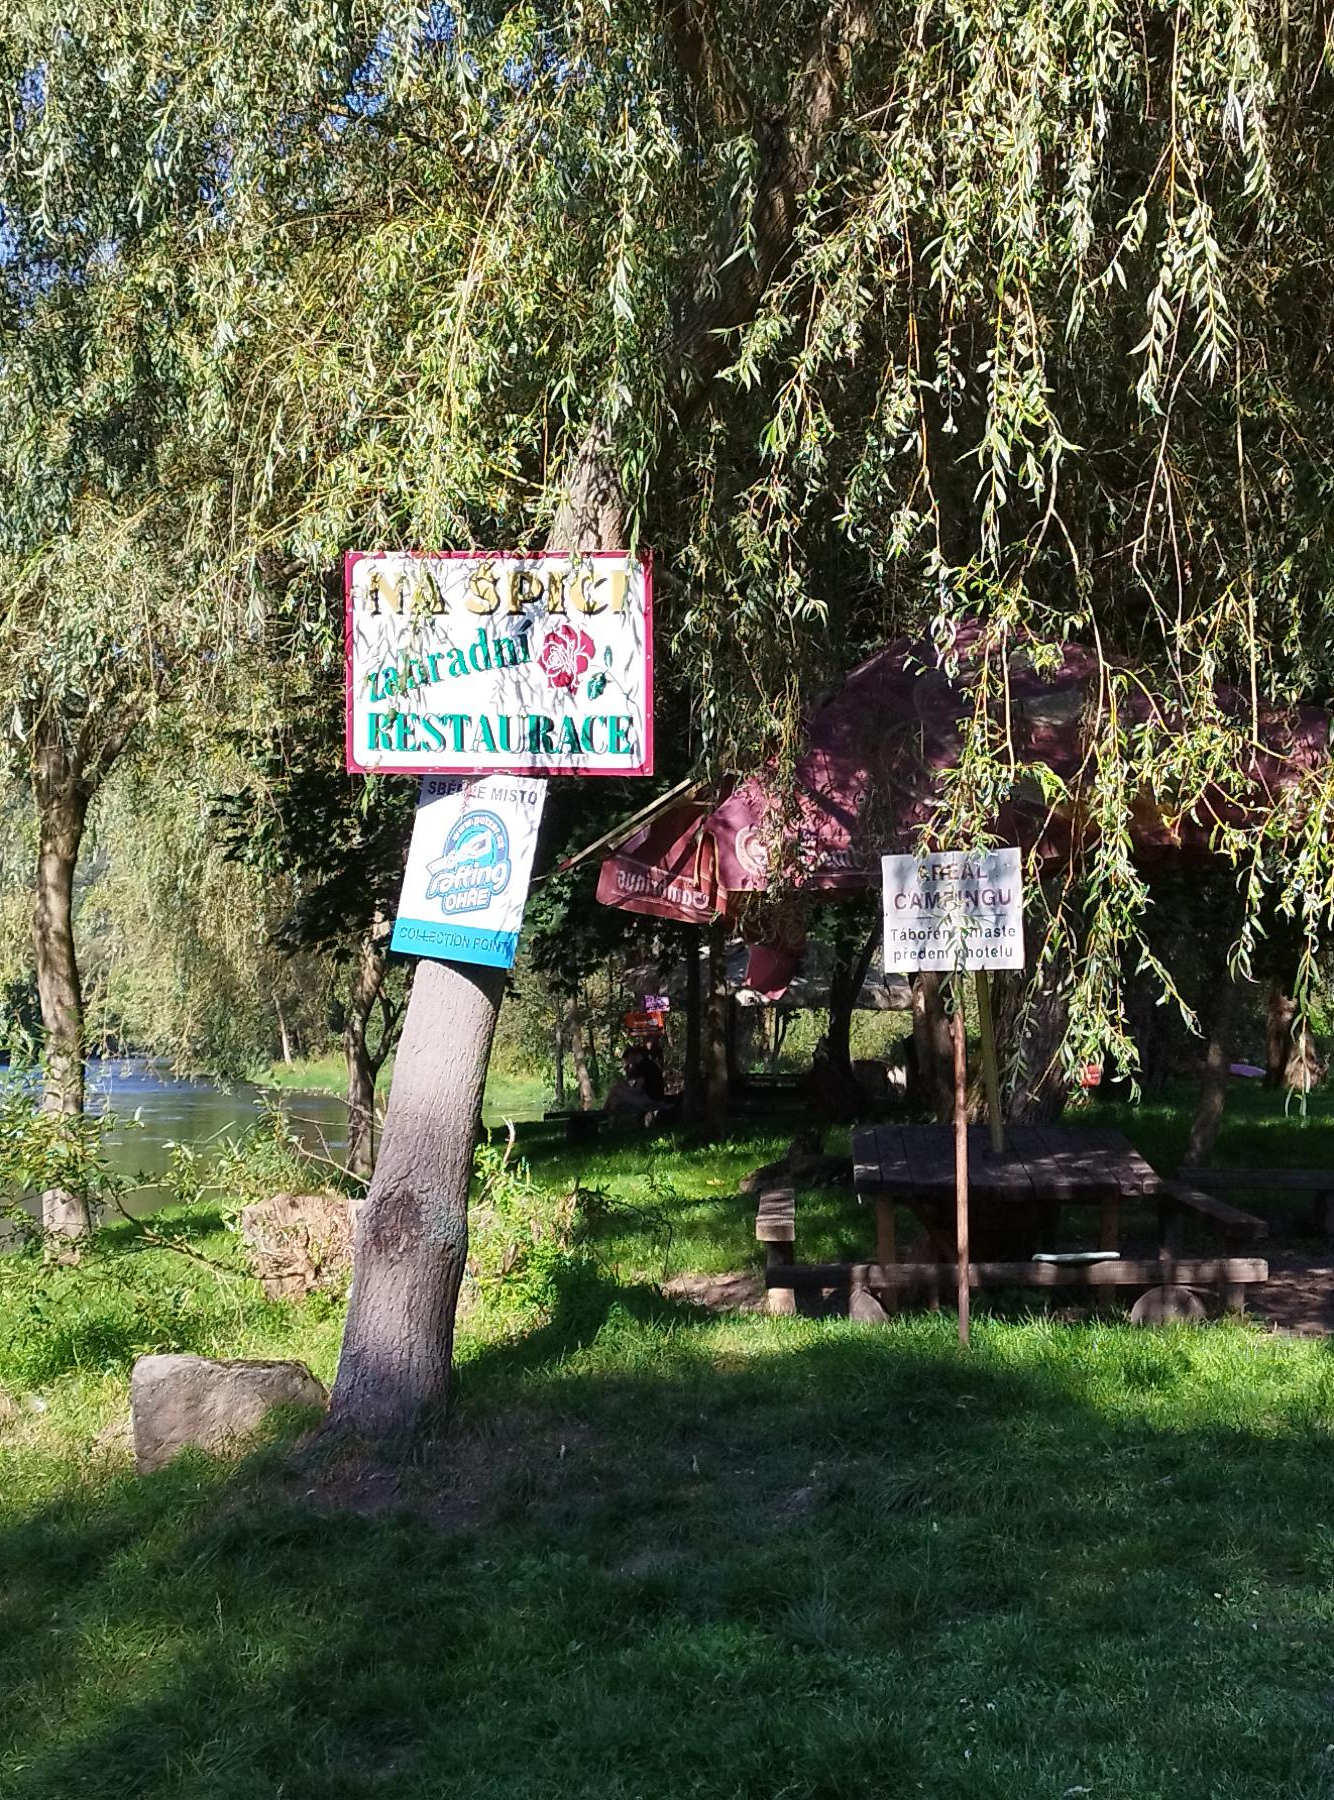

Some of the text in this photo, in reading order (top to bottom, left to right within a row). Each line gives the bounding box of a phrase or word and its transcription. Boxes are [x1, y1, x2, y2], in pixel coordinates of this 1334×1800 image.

[368, 571, 449, 615] NA
[367, 712, 634, 755] RESTAURACE
[400, 927, 509, 955] COLLECTION POINT
